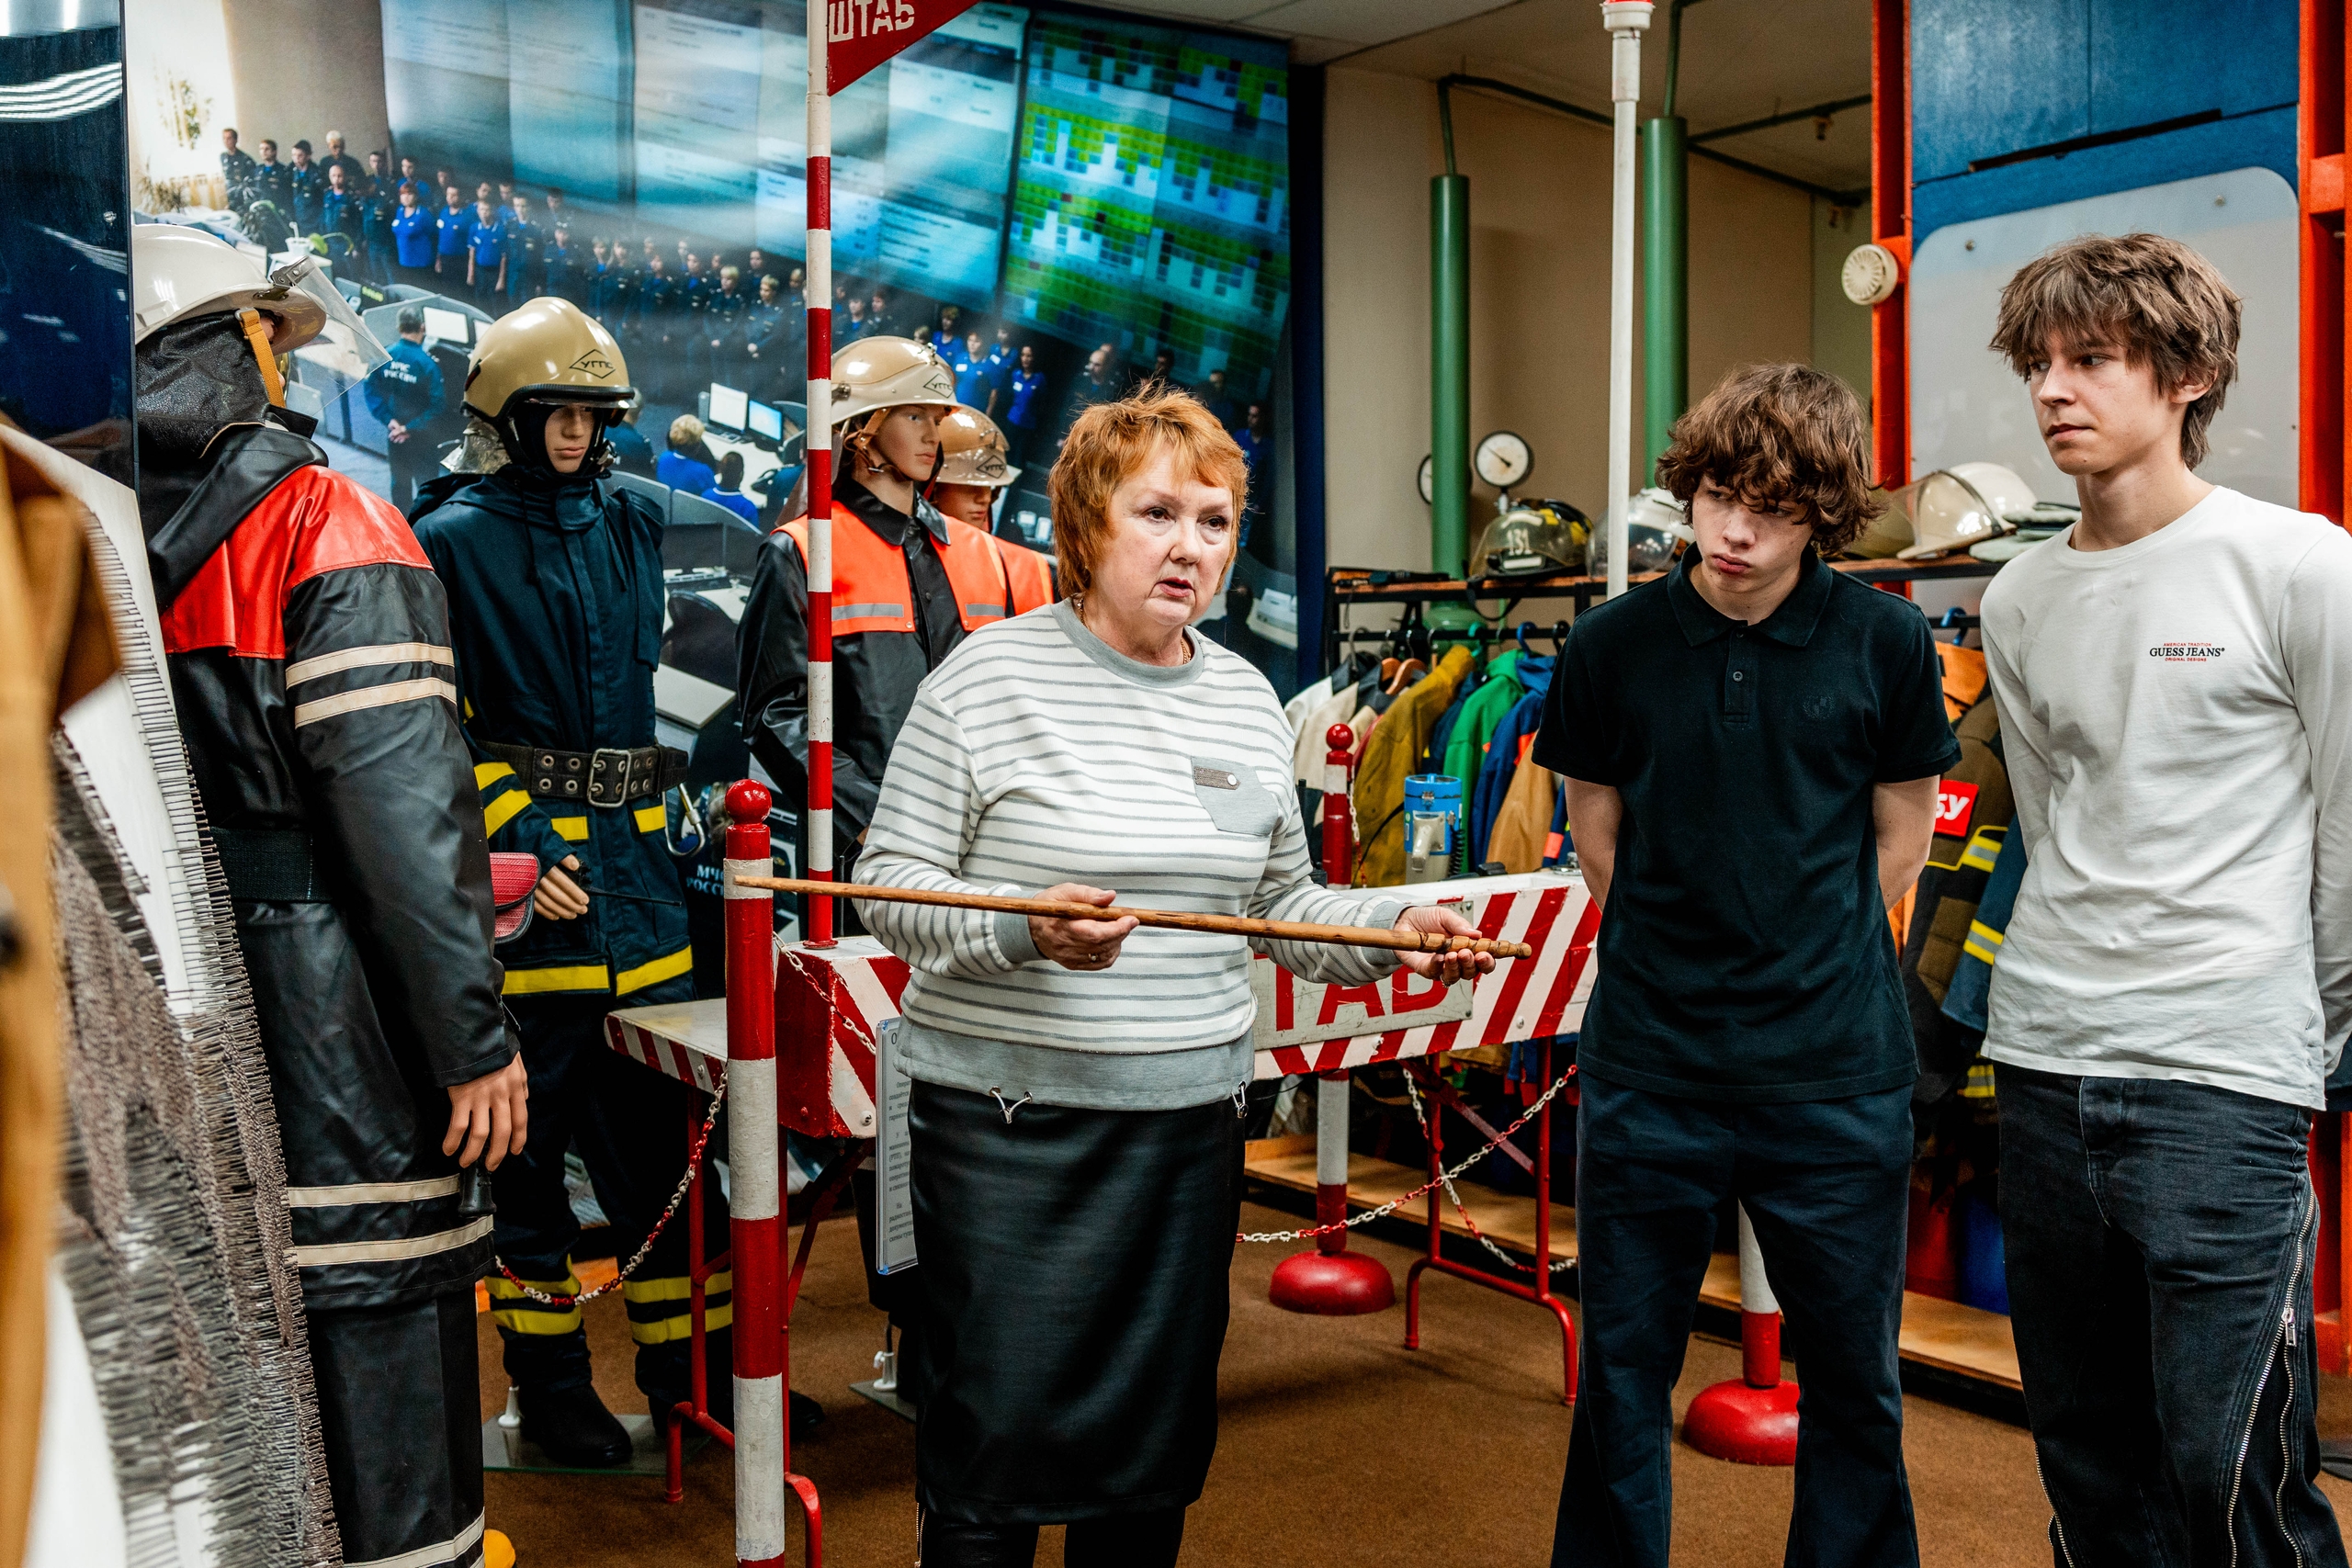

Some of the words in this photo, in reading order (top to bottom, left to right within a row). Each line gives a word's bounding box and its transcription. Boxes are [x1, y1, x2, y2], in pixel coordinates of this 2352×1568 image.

[829, 0, 915, 42] ШТАБ
[1507, 529, 1532, 557] 131
[2149, 647, 2185, 658] GUESS
[686, 876, 724, 897] РОСС
[1253, 953, 1450, 1032] ТАБ
